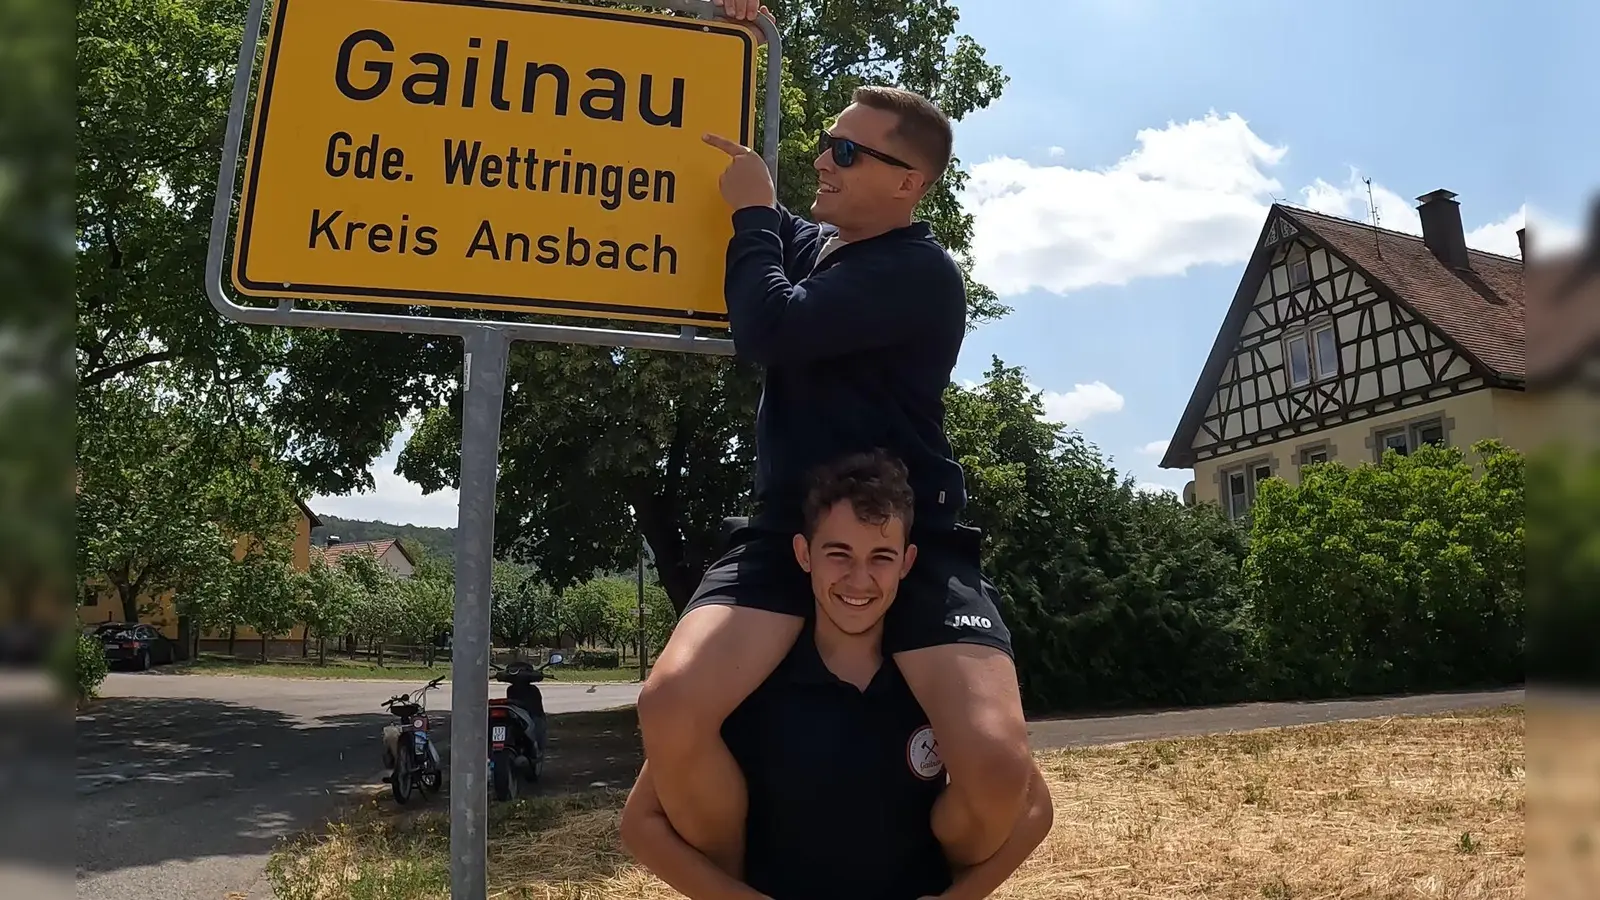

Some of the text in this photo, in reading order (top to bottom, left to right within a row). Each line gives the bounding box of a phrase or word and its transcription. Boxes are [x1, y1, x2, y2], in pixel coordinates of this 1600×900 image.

[334, 29, 685, 129] Gailnau
[325, 131, 676, 211] Gde. Wettringen
[308, 208, 678, 275] Kreis Ansbach
[952, 615, 992, 629] JAKO
